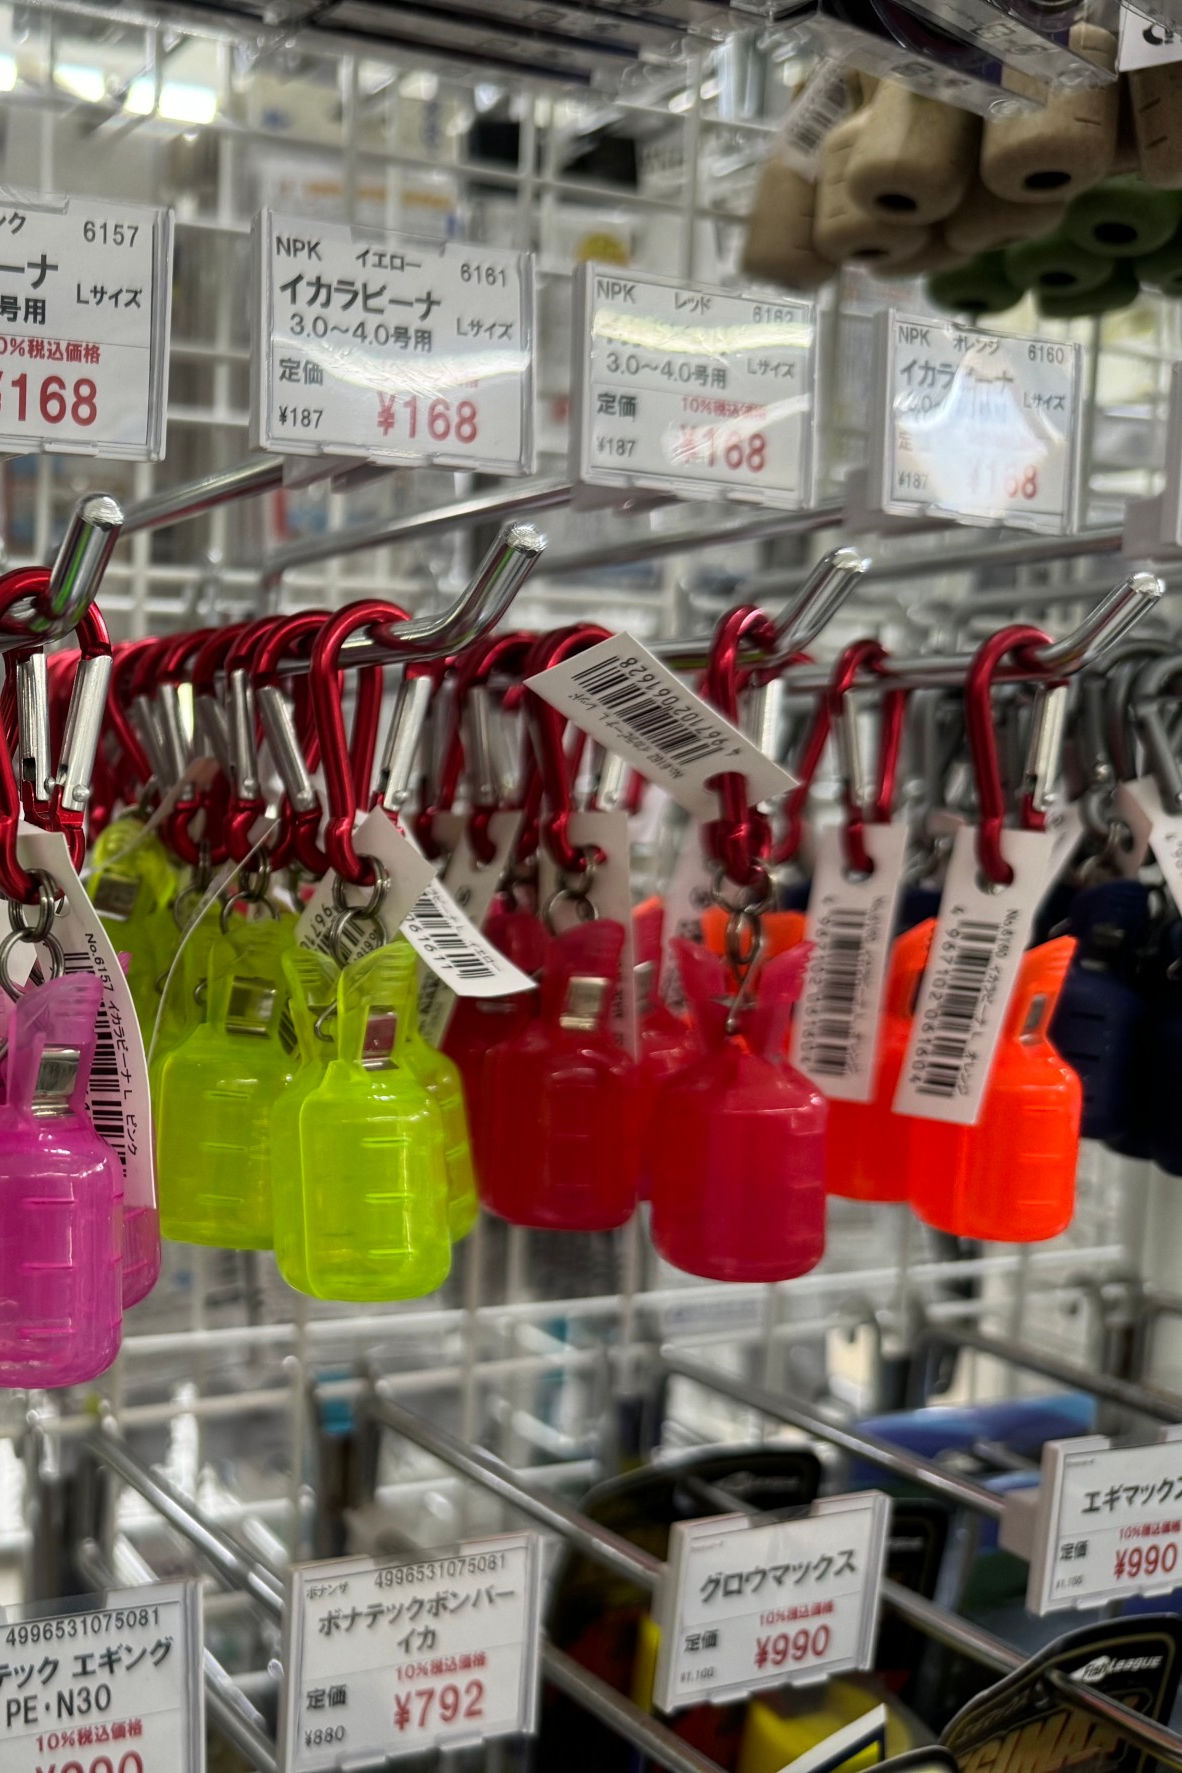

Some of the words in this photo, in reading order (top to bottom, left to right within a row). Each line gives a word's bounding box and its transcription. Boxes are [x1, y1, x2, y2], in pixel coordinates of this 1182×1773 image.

[82, 220, 140, 248] 6157
[275, 235, 323, 262] NPK
[355, 248, 423, 273] イエロー
[459, 262, 508, 289] 6161
[76, 283, 142, 310] Lサイズ
[279, 273, 443, 322] イカラビーナ
[597, 279, 637, 304] NPK
[674, 291, 711, 316] レッド
[456, 316, 514, 341] Lサイズ
[898, 325, 931, 348] NPK
[953, 333, 1000, 356] オレンジ
[1027, 343, 1065, 365] 6160
[278, 357, 324, 386] 定価
[746, 357, 796, 379] Lサイズ
[899, 357, 1015, 393] イカラーナ
[278, 405, 324, 430] ¥187
[376, 390, 479, 445] ¥168
[597, 391, 637, 419] 定価
[1023, 390, 1066, 411] Lサイズ
[596, 435, 637, 459] ¥187
[897, 469, 930, 490] ¥187
[619, 656, 680, 706] 061628
[84, 932, 115, 992] No.6157
[107, 999, 134, 1084] イカラビーナ
[123, 1088, 134, 1100] L
[126, 1113, 139, 1156] ピンク
[1059, 1540, 1089, 1561] 定価
[1114, 1542, 1179, 1581] ¥990
[374, 1552, 507, 1589] 4996531075081
[699, 1548, 857, 1604] グロウマックス
[5, 1606, 161, 1648] 4996531075081
[318, 1584, 516, 1637] ボナテックボンバー
[71, 1635, 174, 1679] エギング
[397, 1625, 438, 1655] イカ
[684, 1628, 719, 1653] 定価
[754, 1623, 832, 1670] ¥990
[304, 1725, 346, 1748] ¥880
[393, 1678, 484, 1732] ¥792
[306, 1683, 348, 1711] 定価
[35, 1717, 144, 1753] 10%税込価格
